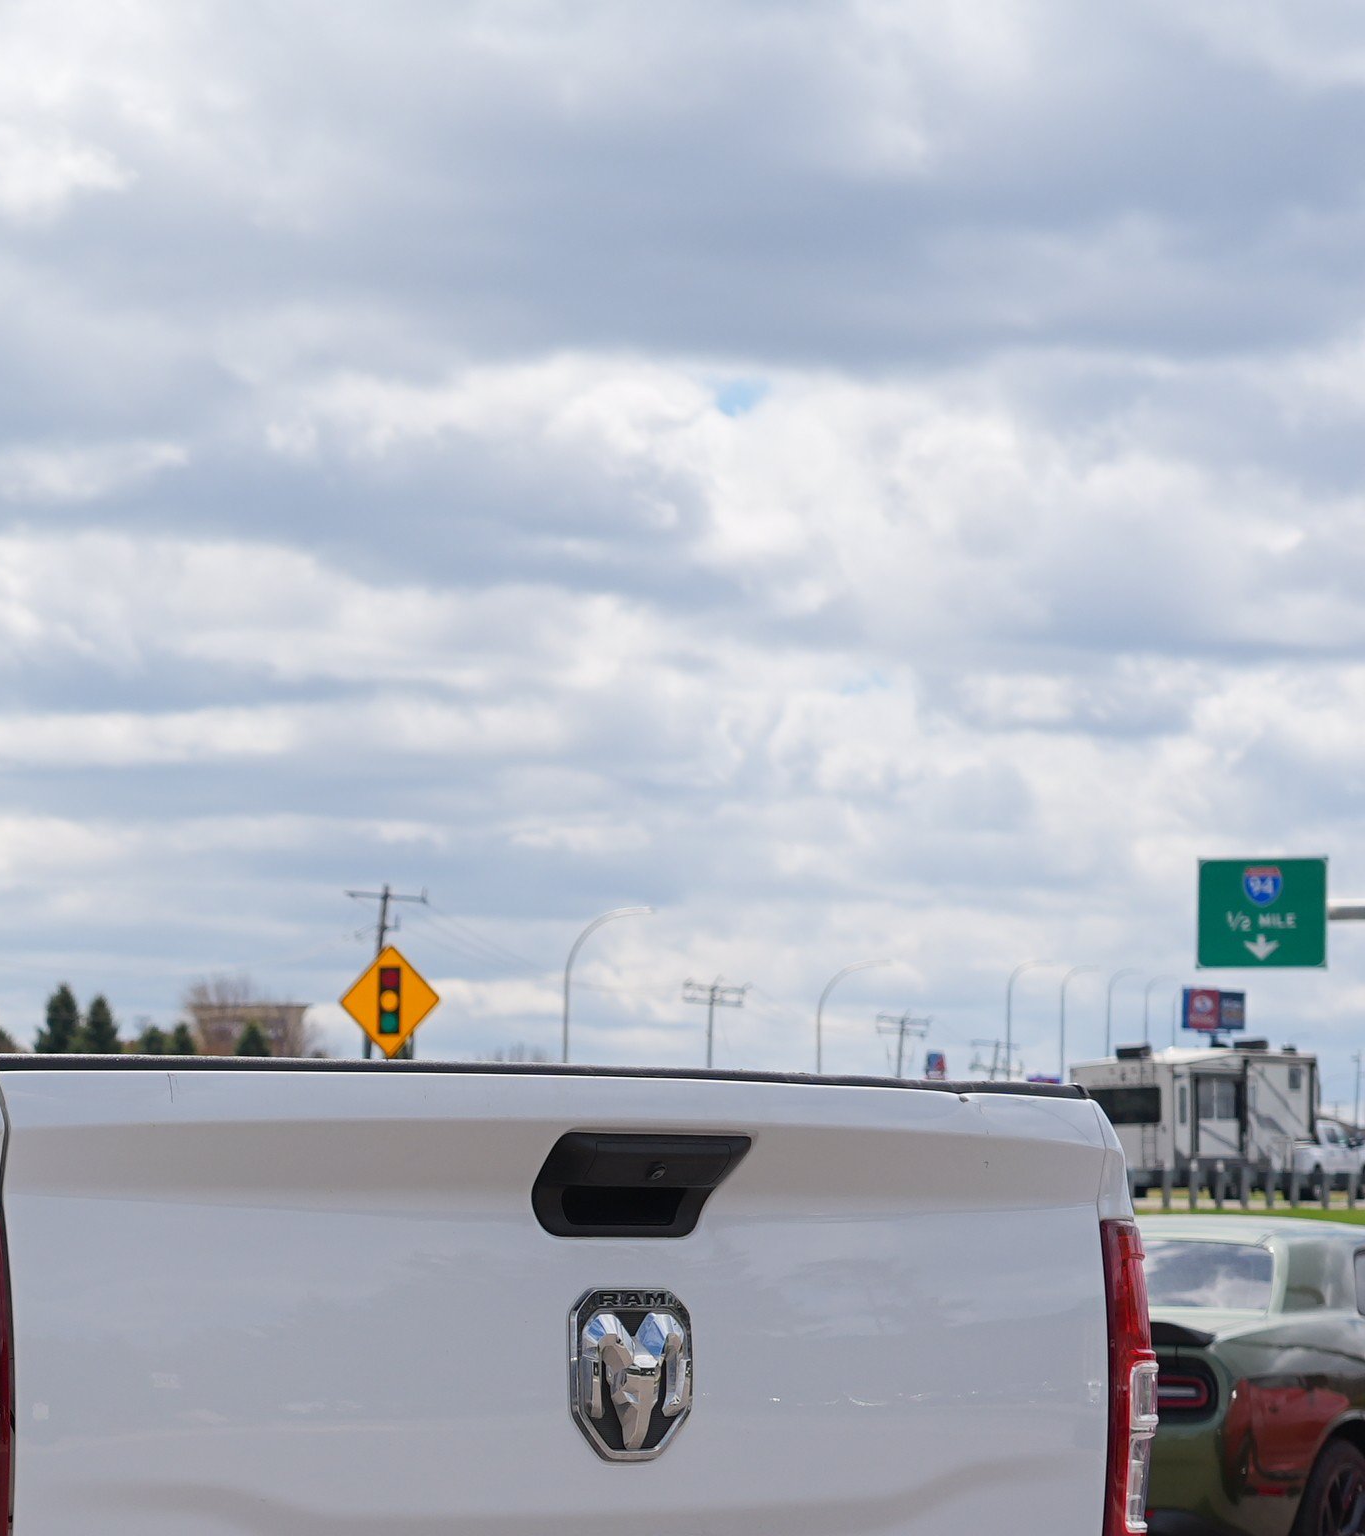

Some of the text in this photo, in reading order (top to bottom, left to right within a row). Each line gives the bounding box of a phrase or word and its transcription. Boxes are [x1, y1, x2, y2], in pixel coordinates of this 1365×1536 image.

[1249, 876, 1275, 896] 94
[1258, 911, 1297, 929] MILE
[598, 1292, 670, 1307] RAM
